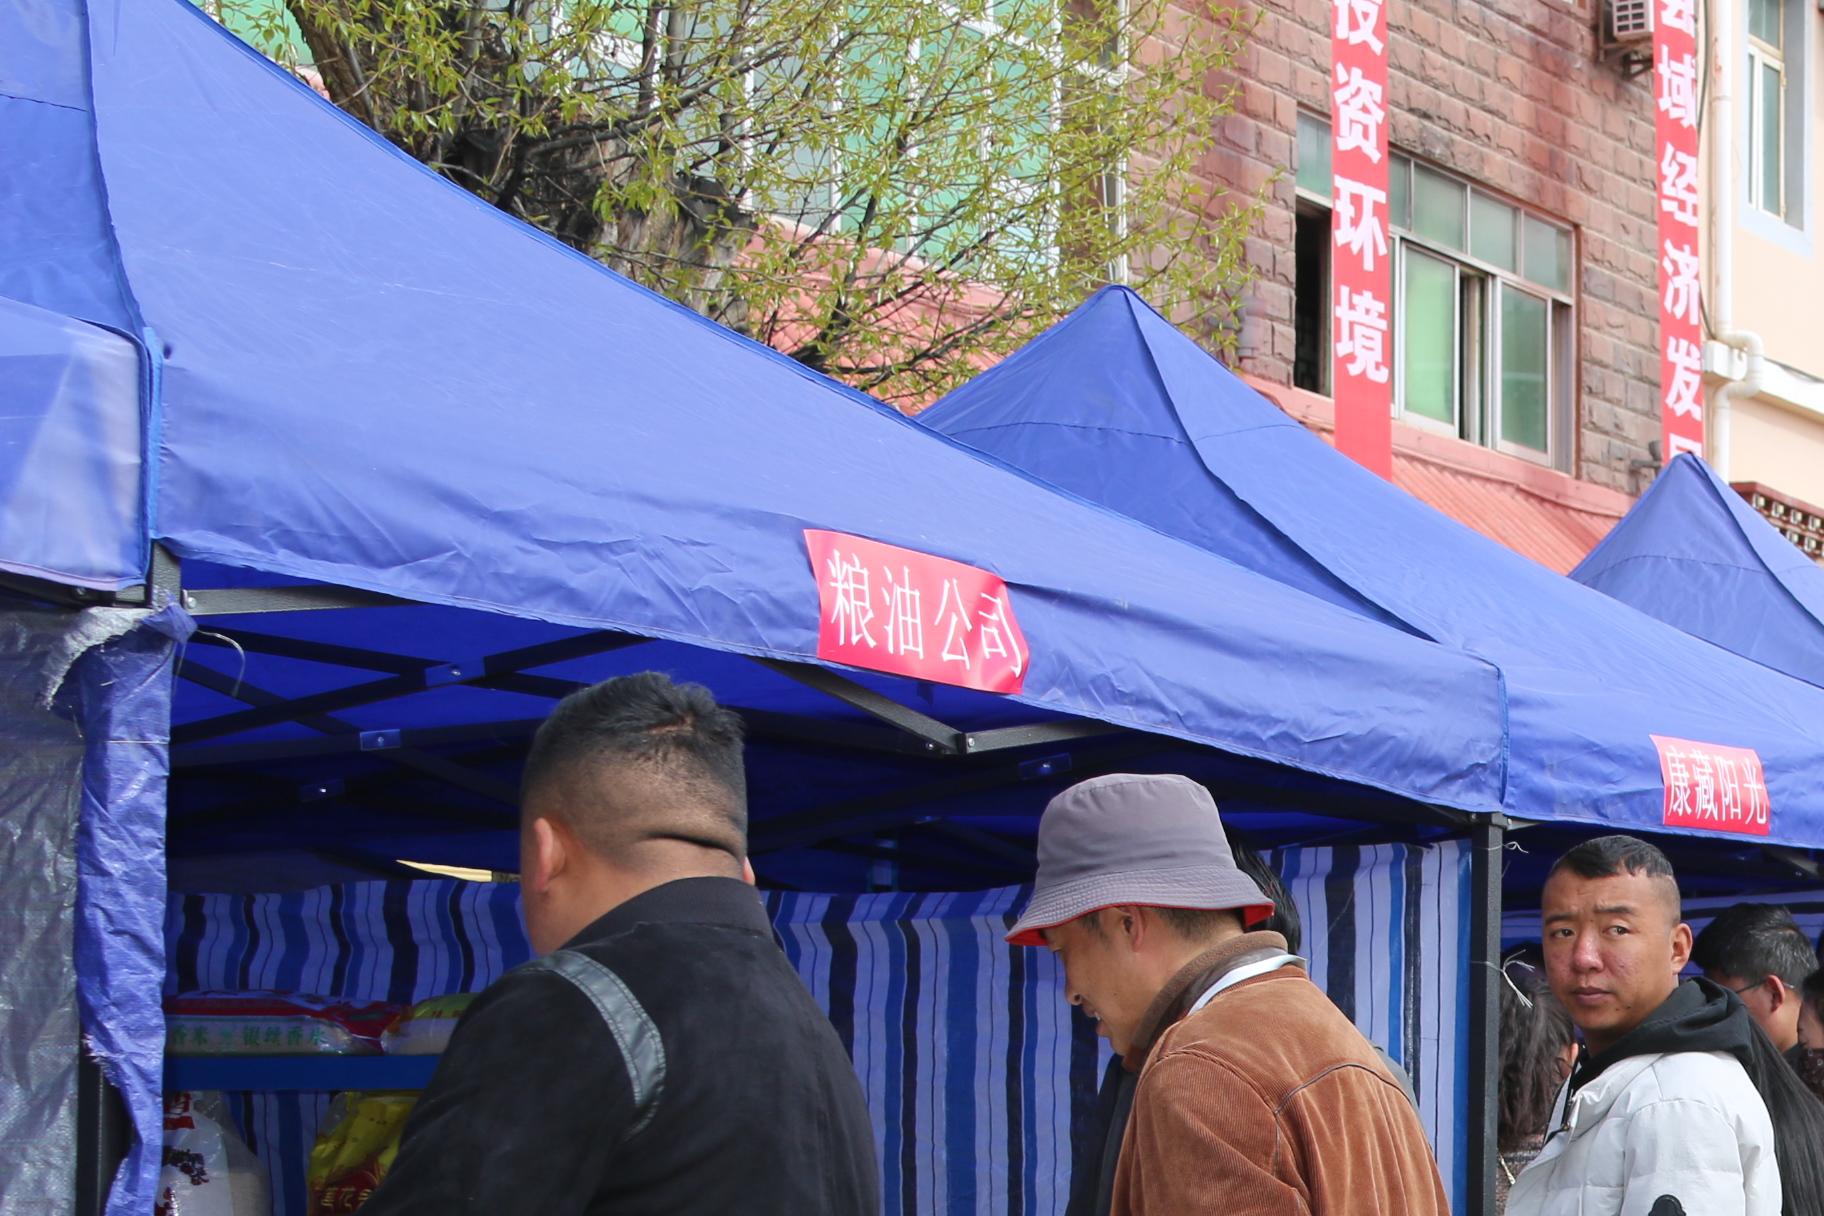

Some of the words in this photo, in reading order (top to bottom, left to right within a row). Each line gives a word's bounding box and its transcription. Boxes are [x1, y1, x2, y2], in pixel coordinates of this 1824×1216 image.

[826, 547, 1025, 678] 粮油公司
[1665, 745, 1768, 826] 康藏阳光
